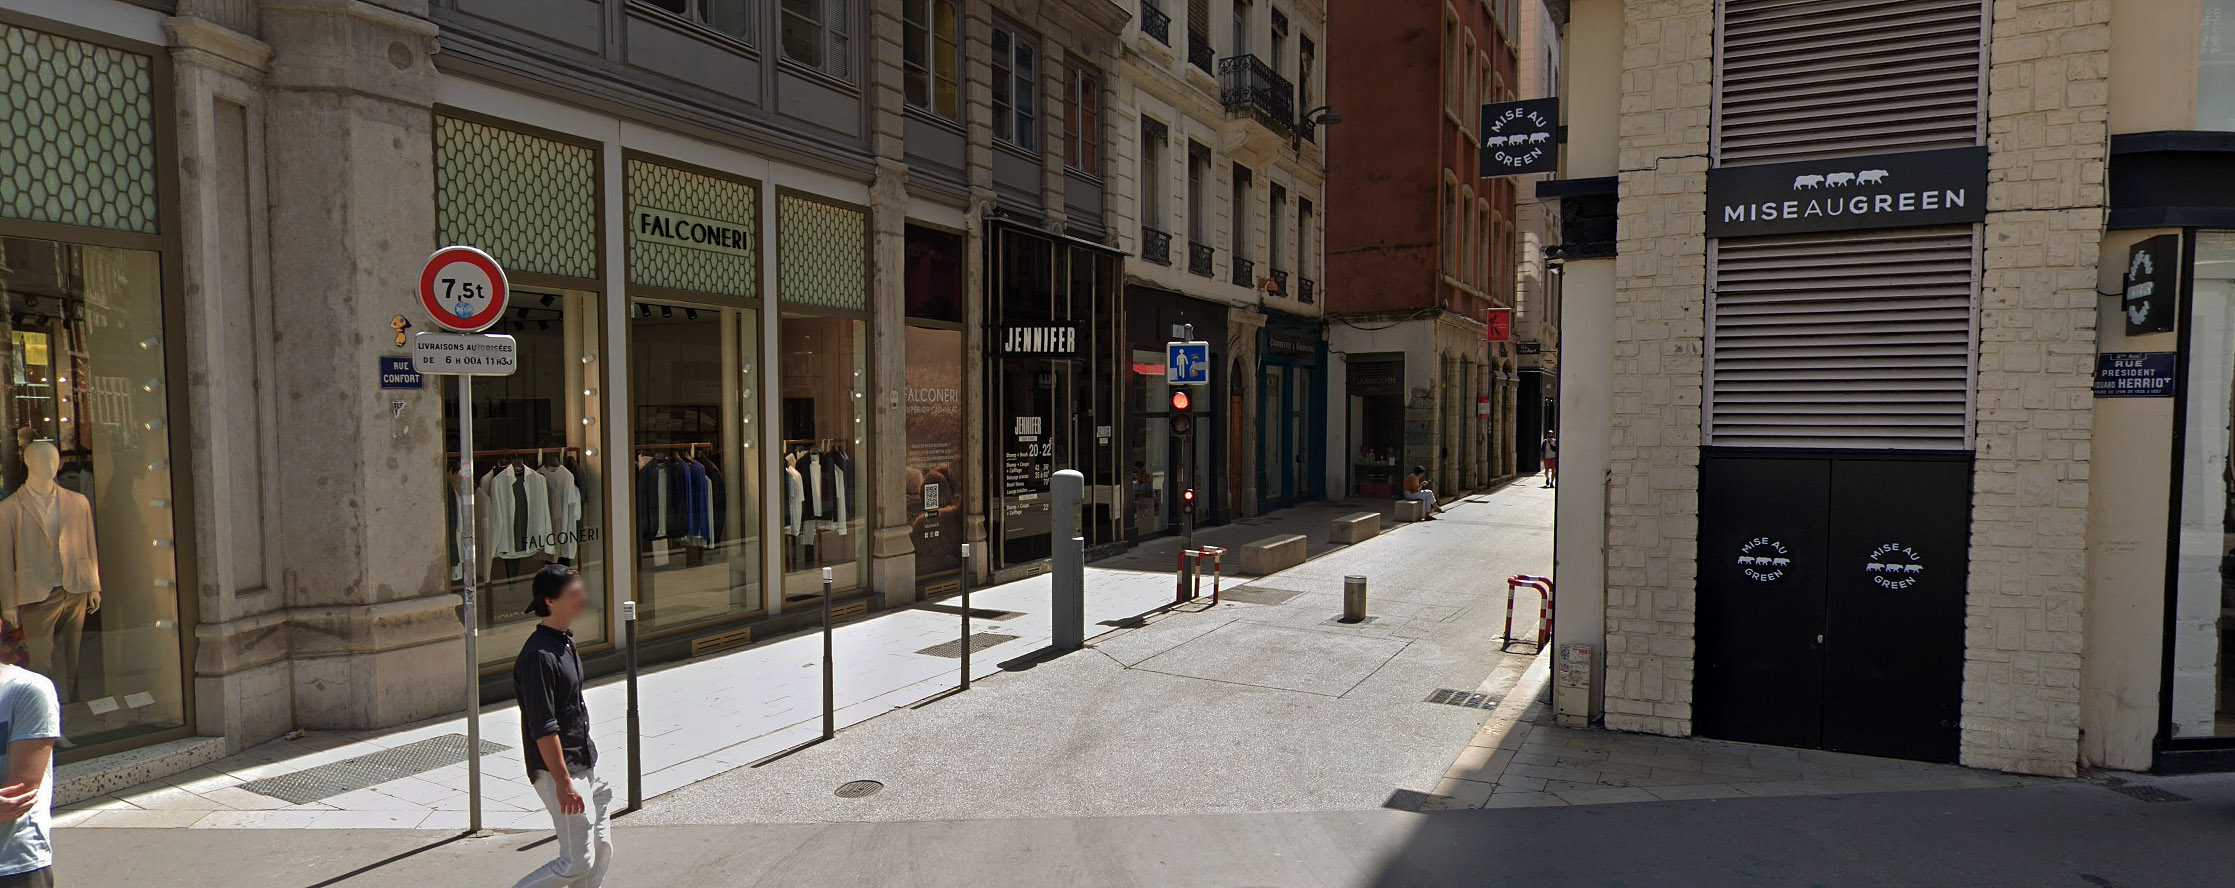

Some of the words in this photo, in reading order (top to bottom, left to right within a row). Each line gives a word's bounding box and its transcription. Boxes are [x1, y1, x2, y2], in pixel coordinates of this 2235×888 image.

[1491, 107, 1523, 133] MISE
[1527, 110, 1547, 128] AU
[1494, 147, 1543, 167] GREEN
[641, 213, 748, 251] FALCONERI
[1005, 326, 1076, 353] JENNIFER
[418, 342, 464, 351] LIVRAISONS
[466, 342, 512, 353] AUTORISÉES
[393, 361, 409, 370] RUE
[423, 356, 435, 364] DE
[445, 355, 452, 364] 6
[2115, 360, 2143, 368] RUE
[383, 374, 420, 383] CONFORT
[904, 387, 958, 403] FALCONERI
[906, 406, 930, 414] UPERIOR
[1014, 416, 1042, 435] JENNIFER
[1028, 443, 1039, 457] 20
[521, 527, 599, 551] FALCONERI
[1741, 536, 1769, 554] MISE
[1771, 540, 1788, 555] AU
[1870, 543, 1900, 560] MISE
[1902, 546, 1921, 562] AU
[1744, 568, 1784, 582] GREEN
[1873, 575, 1917, 590] GREEN
